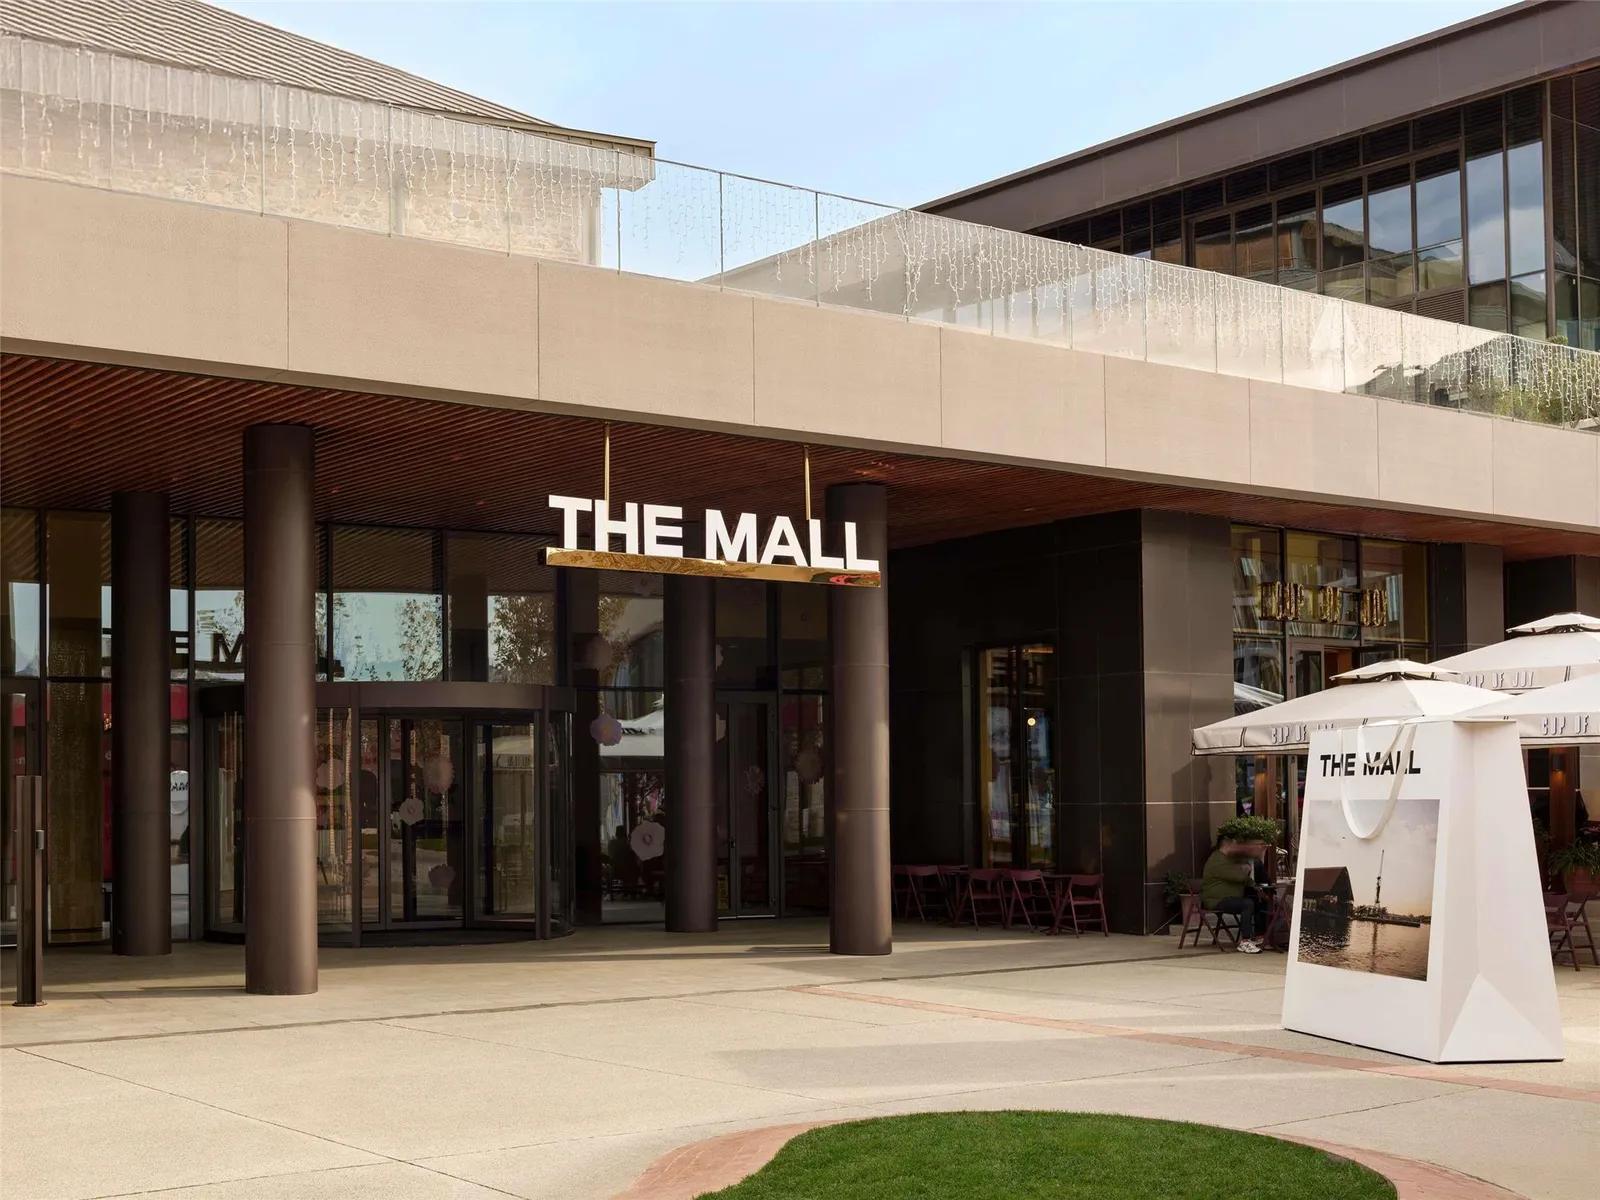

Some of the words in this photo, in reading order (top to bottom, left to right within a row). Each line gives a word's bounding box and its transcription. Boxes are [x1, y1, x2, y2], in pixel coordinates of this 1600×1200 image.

[548, 494, 684, 558] THE
[705, 508, 880, 572] MALL
[1492, 672, 1505, 688] OF
[1513, 671, 1534, 688] JOY
[1271, 726, 1289, 745] CUP
[1295, 723, 1307, 742] OF
[1542, 716, 1566, 736] CUP
[1574, 714, 1589, 735] OF
[1320, 753, 1356, 777] THE
